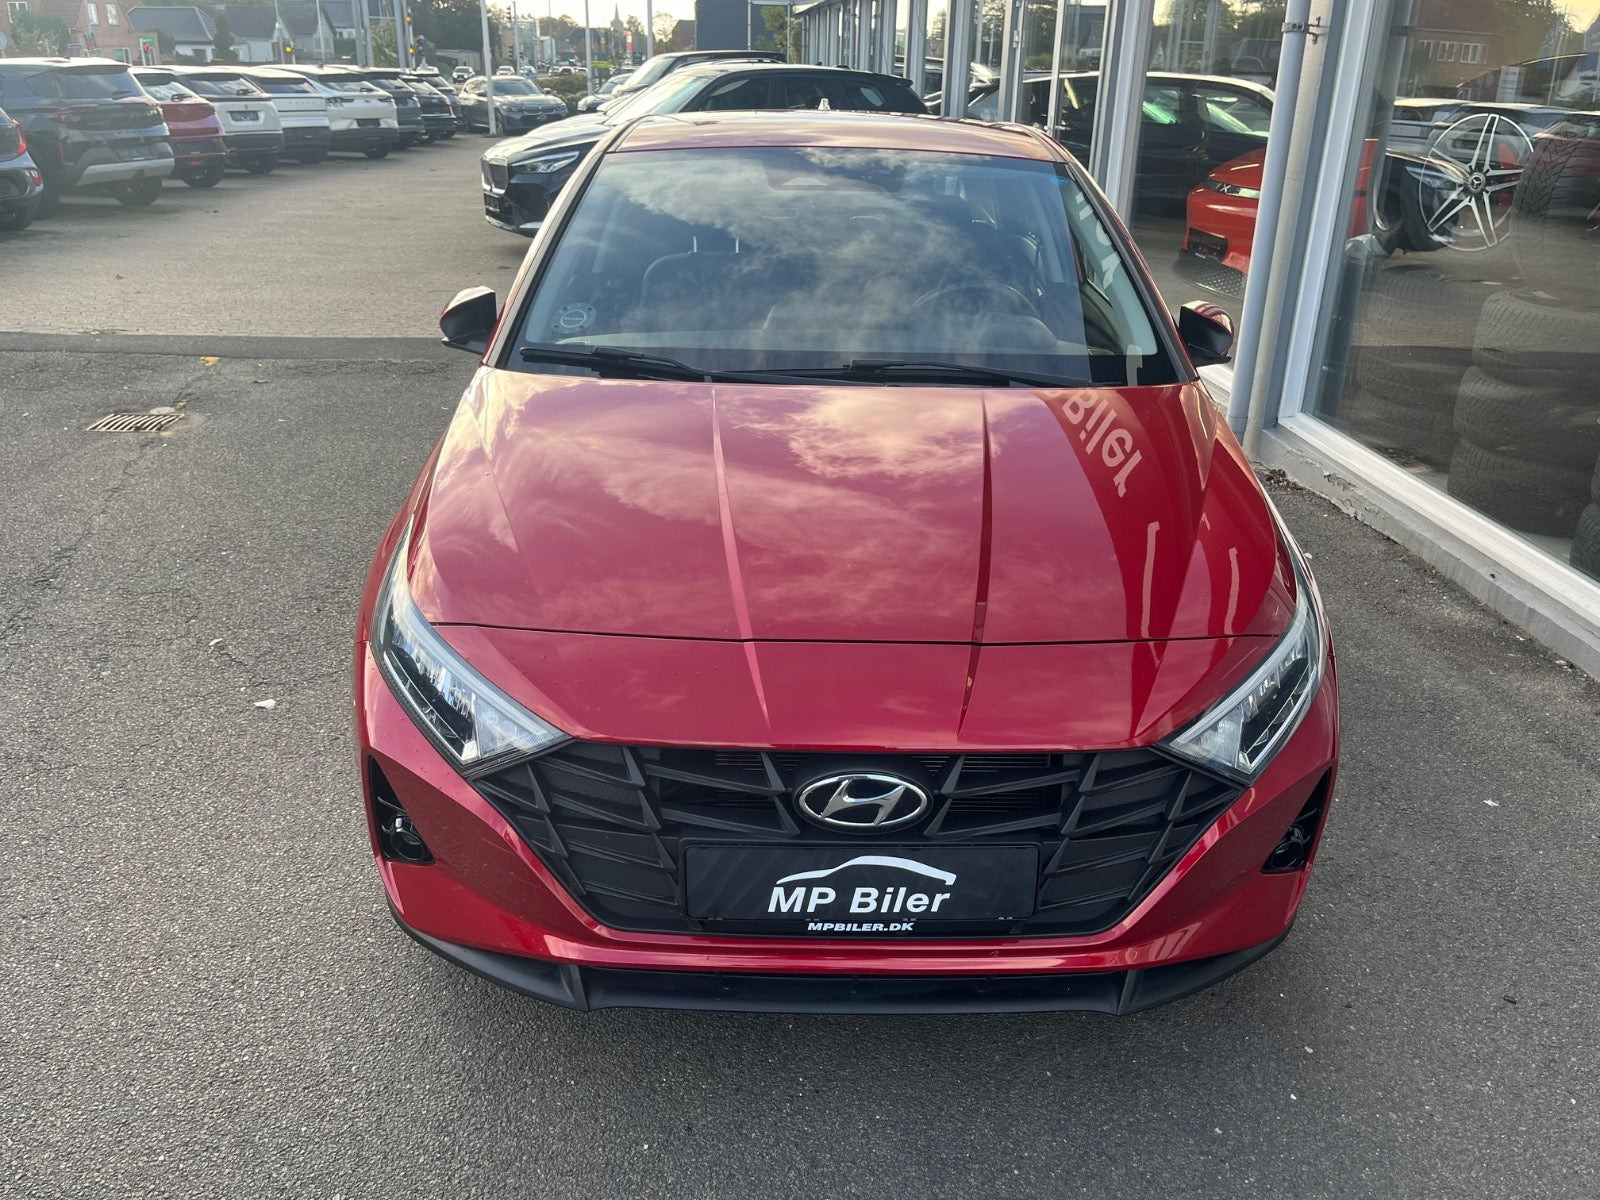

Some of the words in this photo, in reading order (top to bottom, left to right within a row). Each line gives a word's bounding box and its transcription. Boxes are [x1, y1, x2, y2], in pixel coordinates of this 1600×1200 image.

[768, 887, 836, 913] MP
[849, 887, 951, 913] Biler
[807, 922, 915, 932] MPBILER.DK
